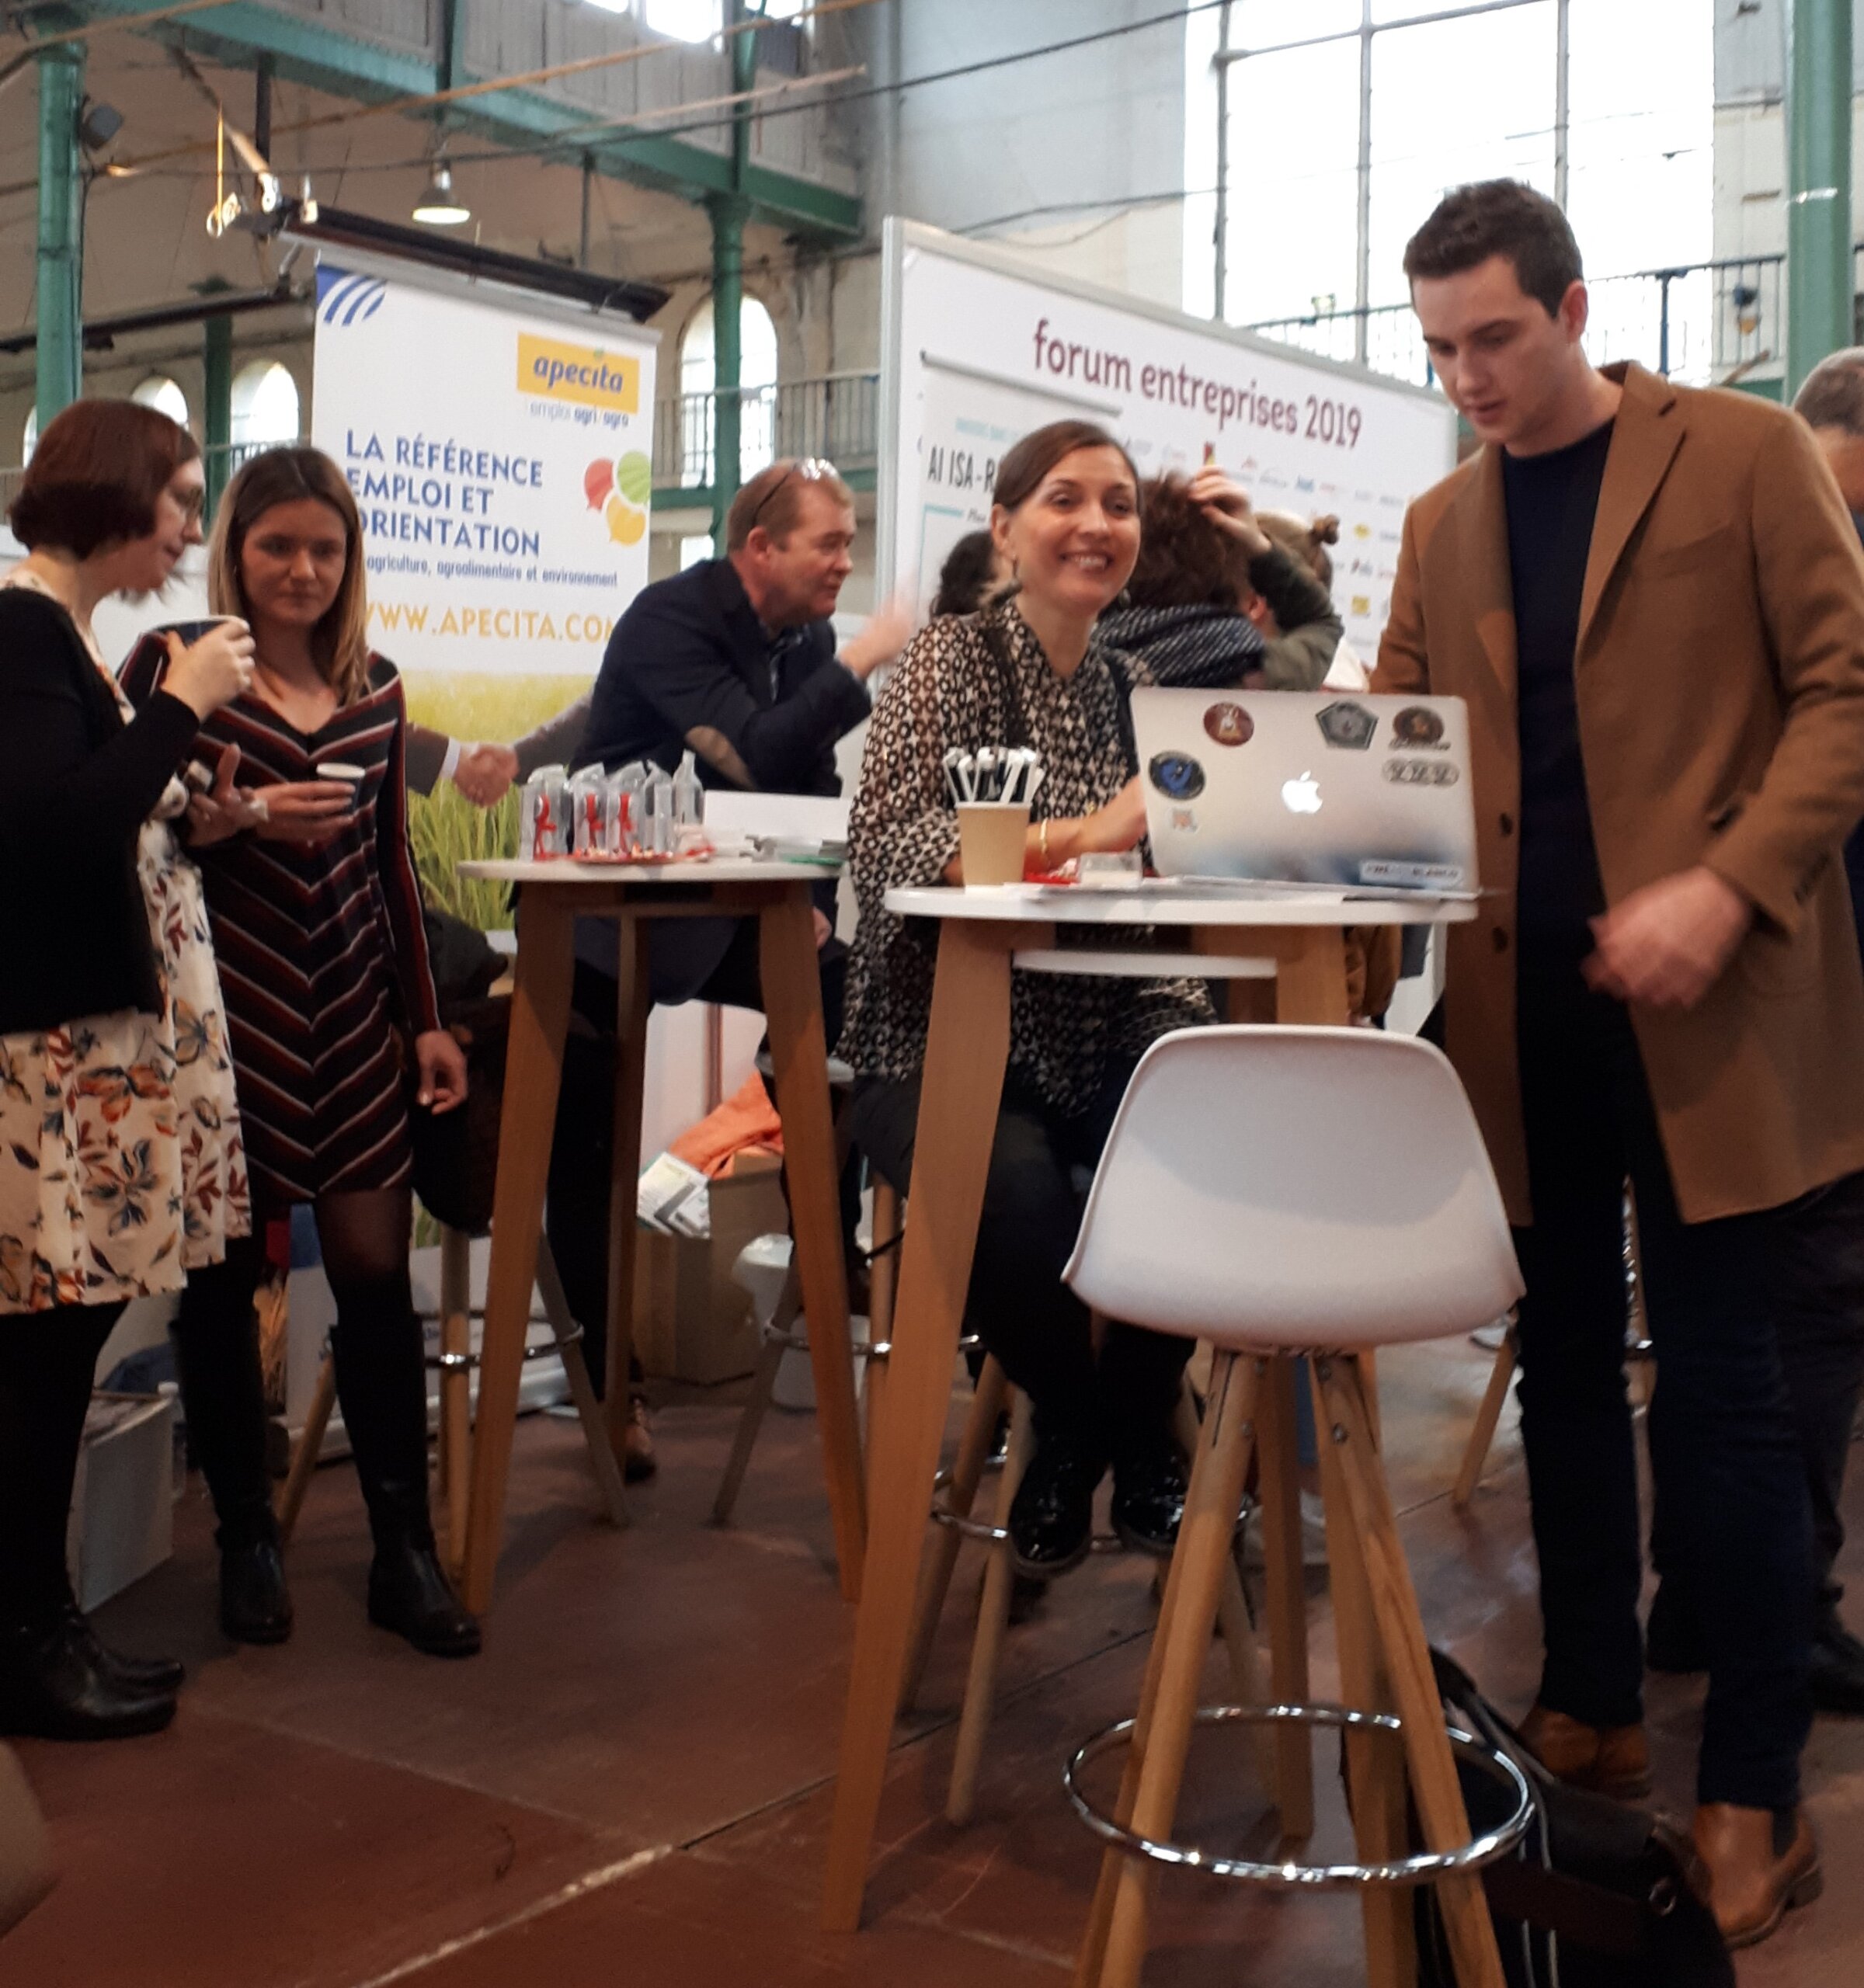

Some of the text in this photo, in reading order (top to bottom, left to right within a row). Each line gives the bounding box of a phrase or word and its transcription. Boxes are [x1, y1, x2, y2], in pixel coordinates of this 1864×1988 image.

[533, 349, 624, 394] apecita
[1034, 317, 1362, 450] forum entreprises 2019
[346, 429, 544, 488] LA RÉFÉRENCE
[346, 467, 495, 517] EMPLOI ET
[367, 552, 618, 587] agriculture, agroalimentaire et environnement
[365, 602, 614, 645] WW.APECITA.CO
